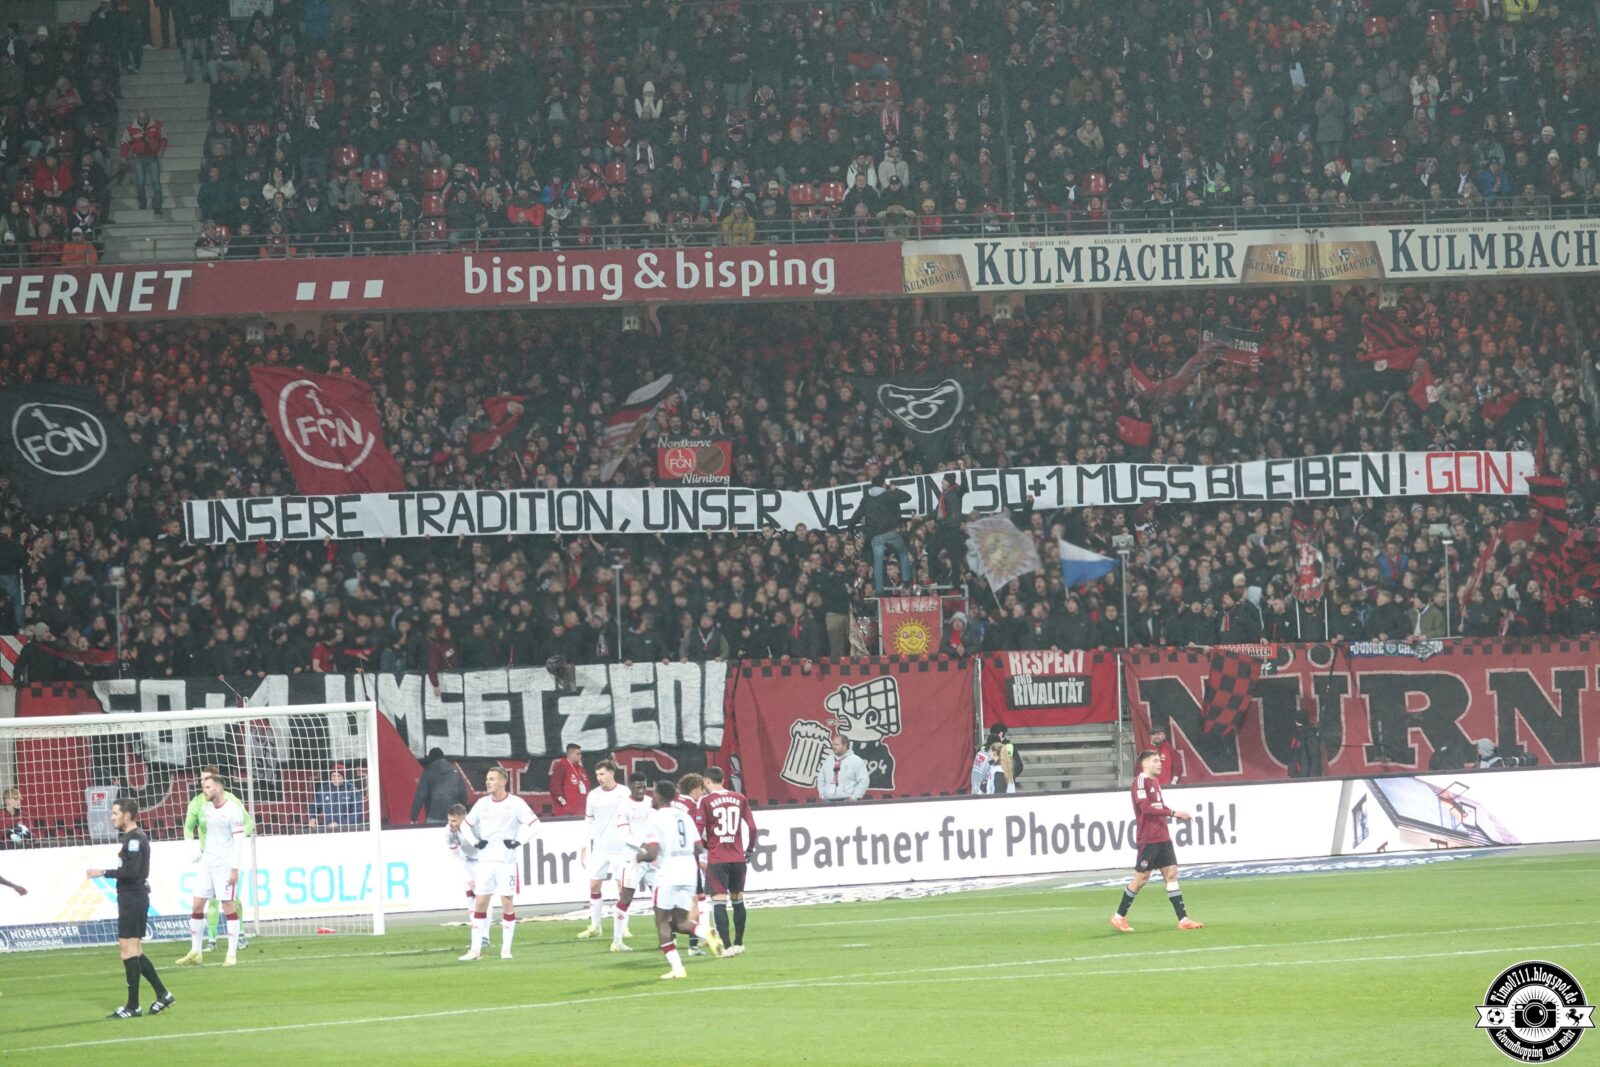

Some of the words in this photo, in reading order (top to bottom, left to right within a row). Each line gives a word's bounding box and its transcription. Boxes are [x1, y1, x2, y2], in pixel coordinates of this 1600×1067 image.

[1388, 224, 1600, 272] KULMBACH
[464, 255, 623, 302] bisping
[633, 252, 668, 290] &
[676, 249, 836, 297] bisping
[974, 241, 1237, 286] KULMBACHER
[1319, 256, 1377, 280] KULMBACHER
[904, 269, 964, 293] KULMBACHER
[304, 389, 334, 416] 1.
[23, 421, 100, 463] FCN
[296, 416, 364, 448] FCN
[657, 435, 713, 449] Nordkurve
[670, 458, 692, 470] FCN
[682, 472, 731, 487] Nürnberg
[186, 494, 365, 546] UNSERE
[388, 489, 631, 536] TRADITION,
[642, 488, 782, 531] UNSER
[808, 474, 950, 530] VEIN
[1076, 464, 1197, 504] MUSS
[1205, 453, 1408, 499] BLEIBEN!
[1007, 648, 1084, 675] RESPEKT
[1352, 640, 1385, 654] JUNGE
[1012, 677, 1084, 706] RIVALITÄT
[1014, 672, 1033, 685] UND
[865, 760, 888, 775] 94
[677, 819, 687, 848] 9
[712, 806, 741, 837] 30
[522, 837, 577, 886] Ihr
[750, 827, 778, 873] &
[789, 824, 930, 871] Partner
[1005, 801, 1237, 858] Photovaik!
[180, 868, 272, 910] SB
